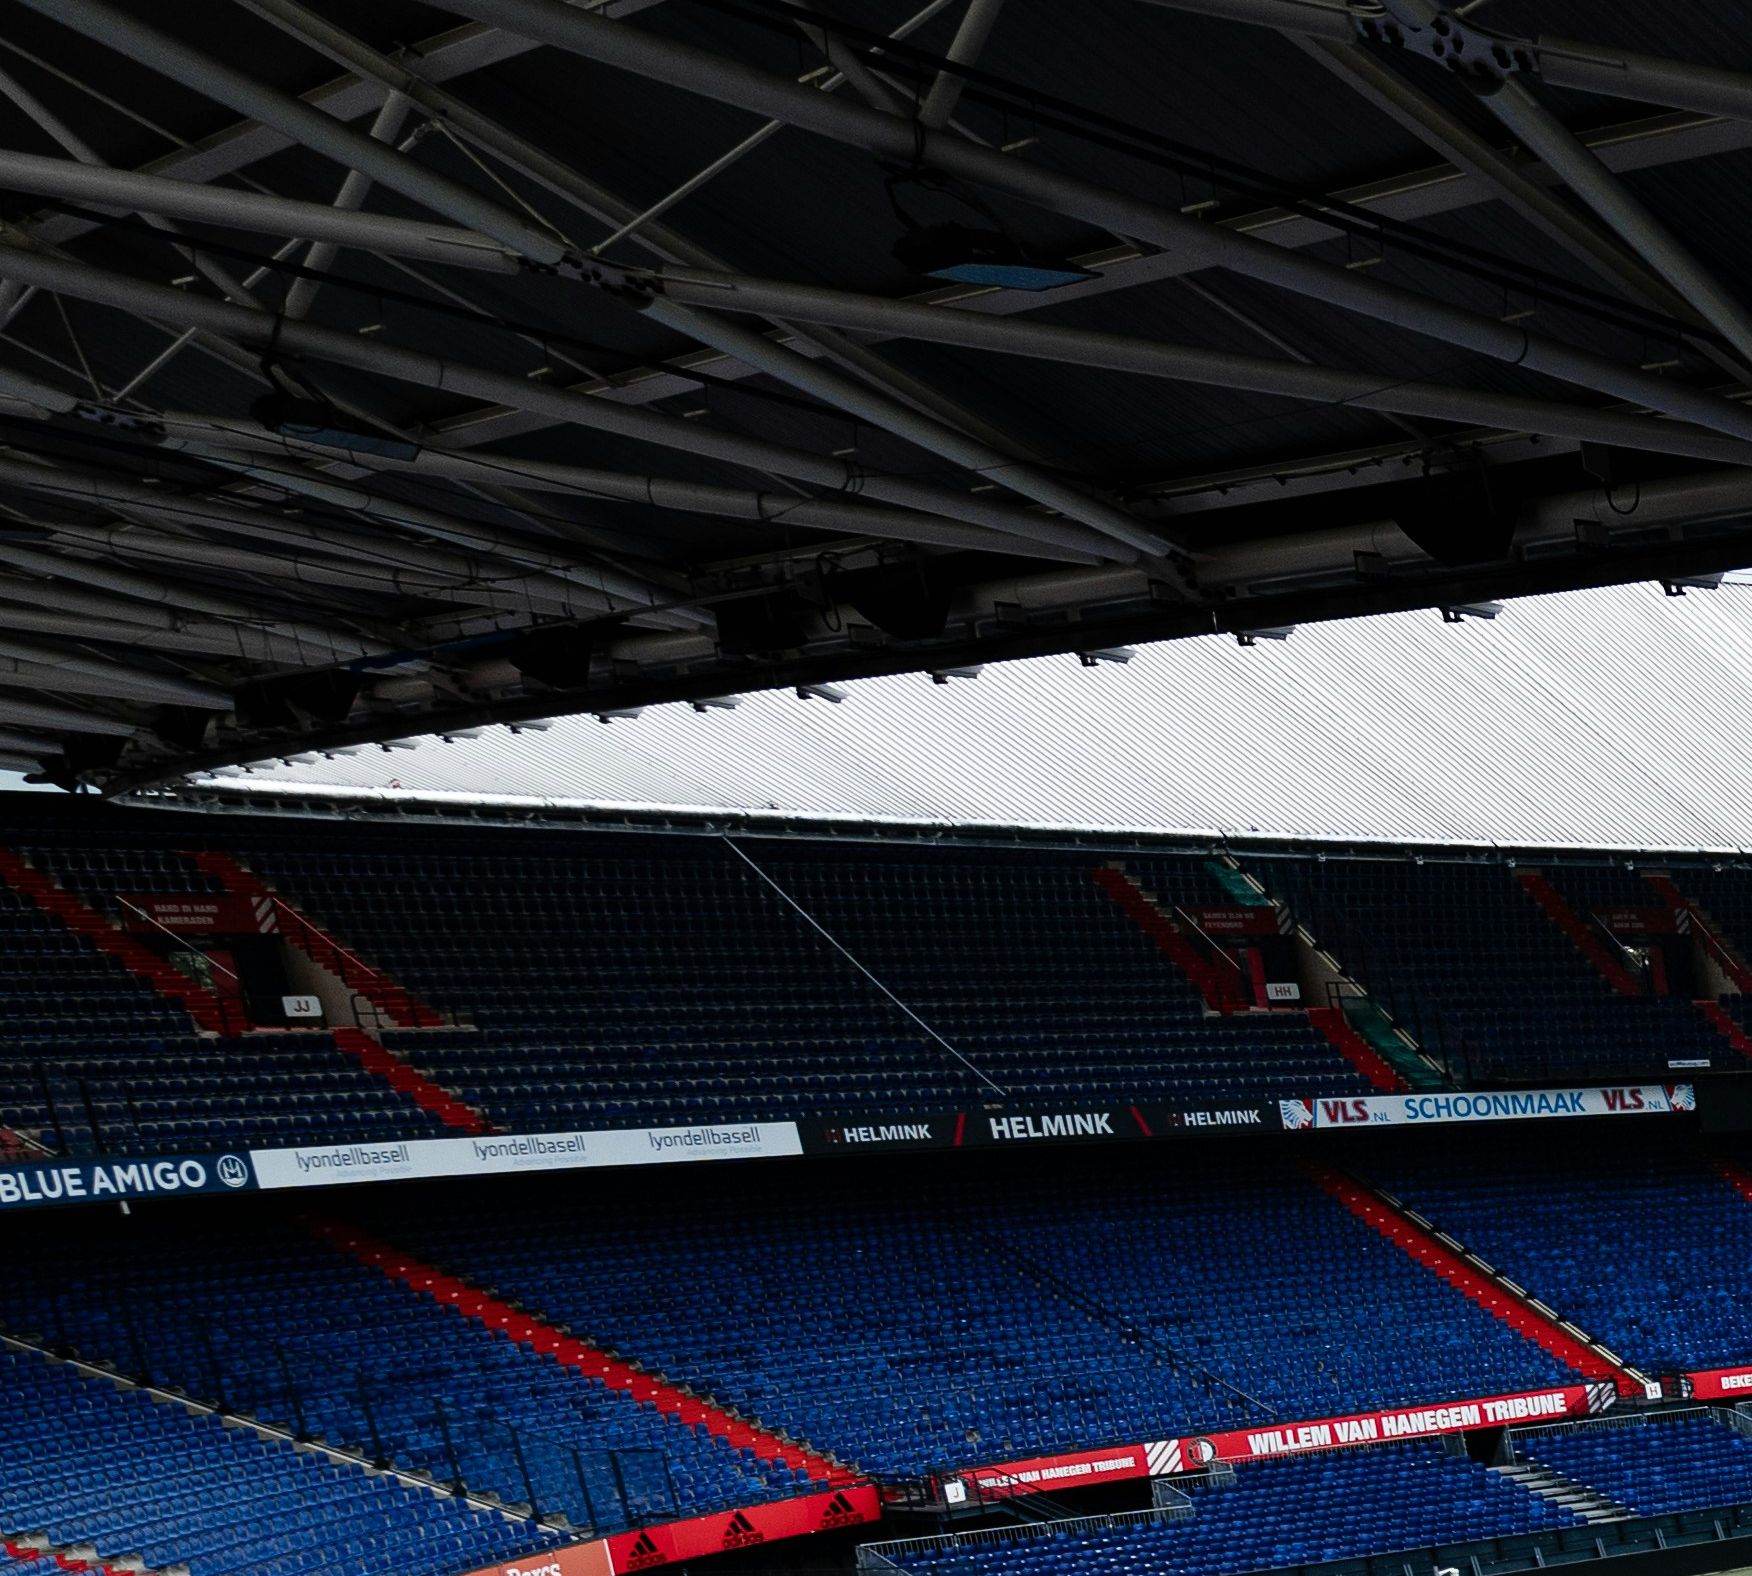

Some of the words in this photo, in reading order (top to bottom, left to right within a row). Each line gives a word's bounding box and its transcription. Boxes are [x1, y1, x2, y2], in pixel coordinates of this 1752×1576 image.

[1274, 986, 1292, 996] HH
[294, 1000, 310, 1012] JJ
[1183, 1109, 1261, 1127] HELMINK
[1404, 1090, 1587, 1121] SCHOONMAAK
[648, 1127, 761, 1152] lyondellbasell
[843, 1124, 932, 1143] HELMINK
[989, 1113, 1114, 1141] HELMINK
[296, 1145, 410, 1173] lyondellbasell
[473, 1135, 586, 1161] lyondellbasell
[0, 1168, 87, 1203] BLUE
[93, 1160, 206, 1194] AMIGO
[1649, 1385, 1658, 1396] H
[1247, 1424, 1330, 1455] WILLEM
[1333, 1417, 1378, 1442] VAN
[1380, 1403, 1480, 1437] HANEGEM
[1482, 1392, 1567, 1422] TRIBUNE
[1020, 1470, 1041, 1483] VAN
[1042, 1464, 1092, 1480] HANEGEM
[1094, 1456, 1136, 1472] TRIBUNE
[820, 1511, 864, 1529] adidas
[626, 1553, 667, 1571] adidas
